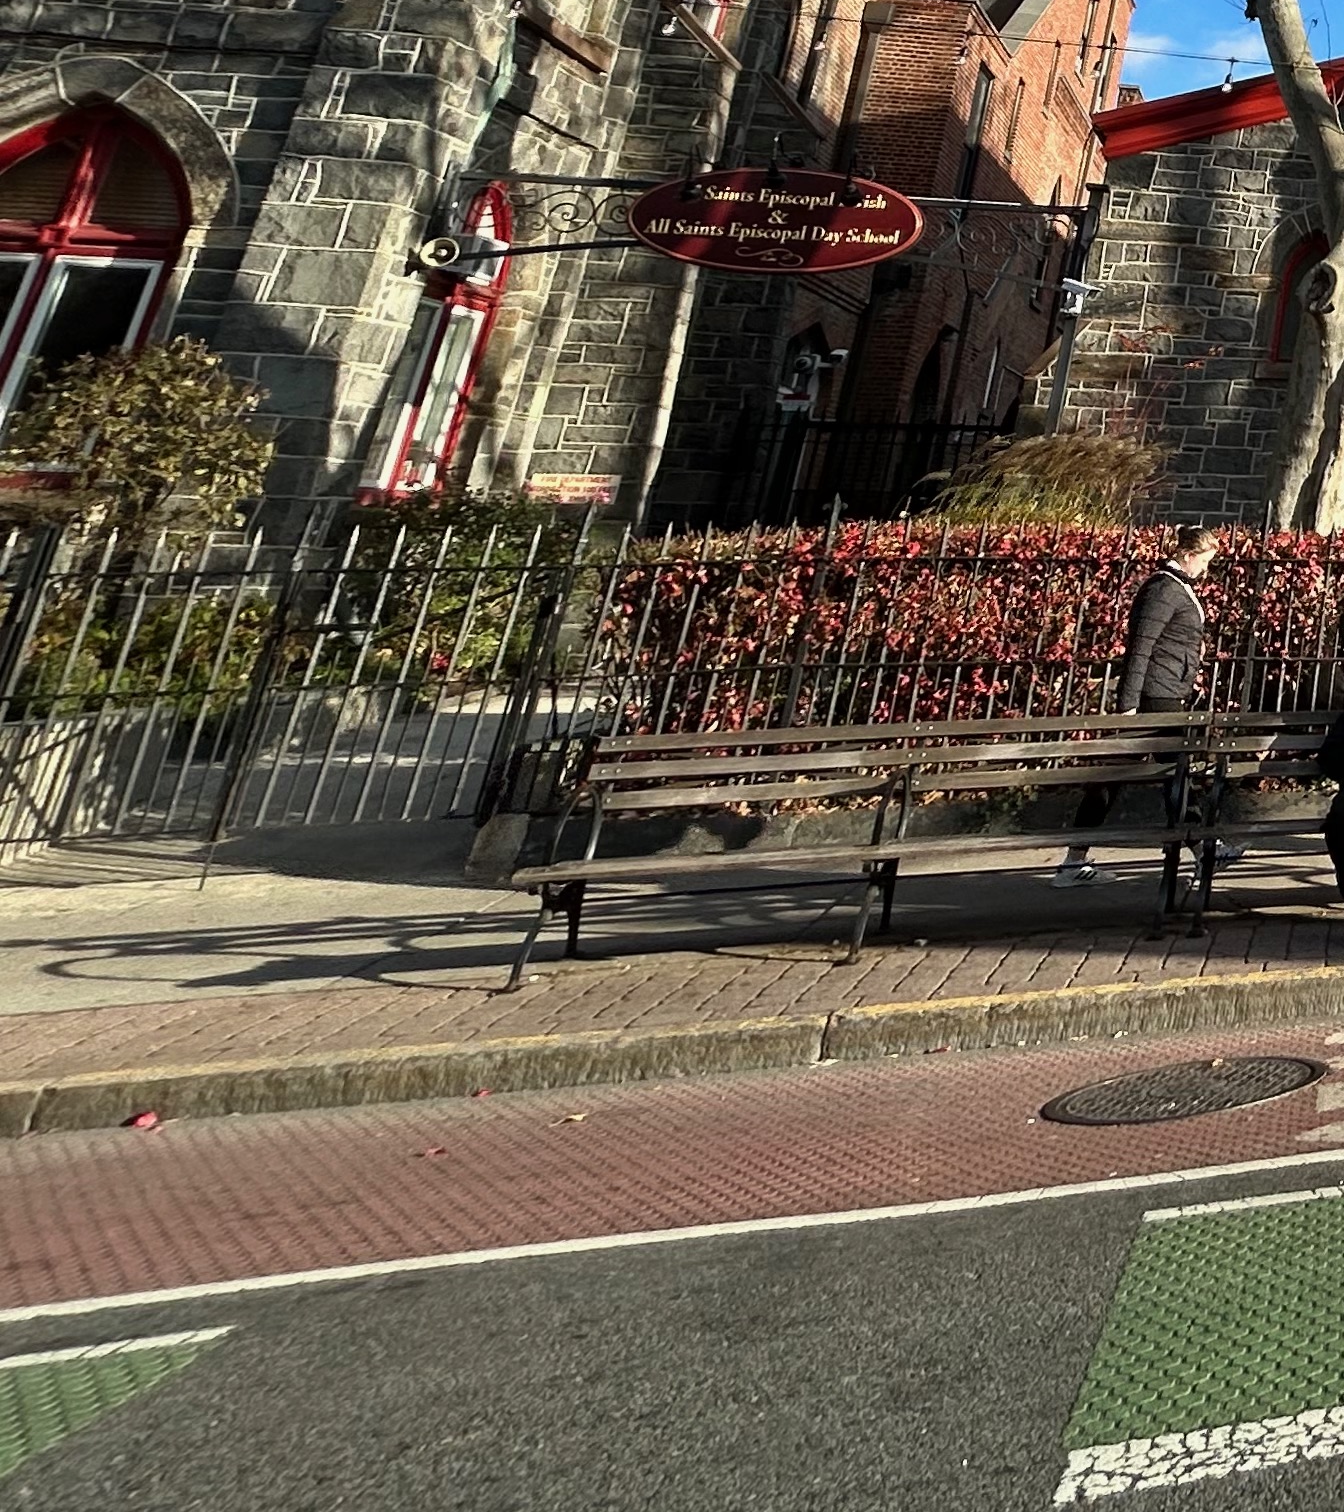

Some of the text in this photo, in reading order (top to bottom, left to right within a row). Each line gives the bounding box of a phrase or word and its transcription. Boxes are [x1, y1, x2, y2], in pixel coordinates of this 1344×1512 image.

[704, 185, 755, 202] Saints
[758, 188, 836, 210] Episcopal
[768, 209, 789, 225] &
[643, 217, 901, 246] All Saints Episcopal Day School
